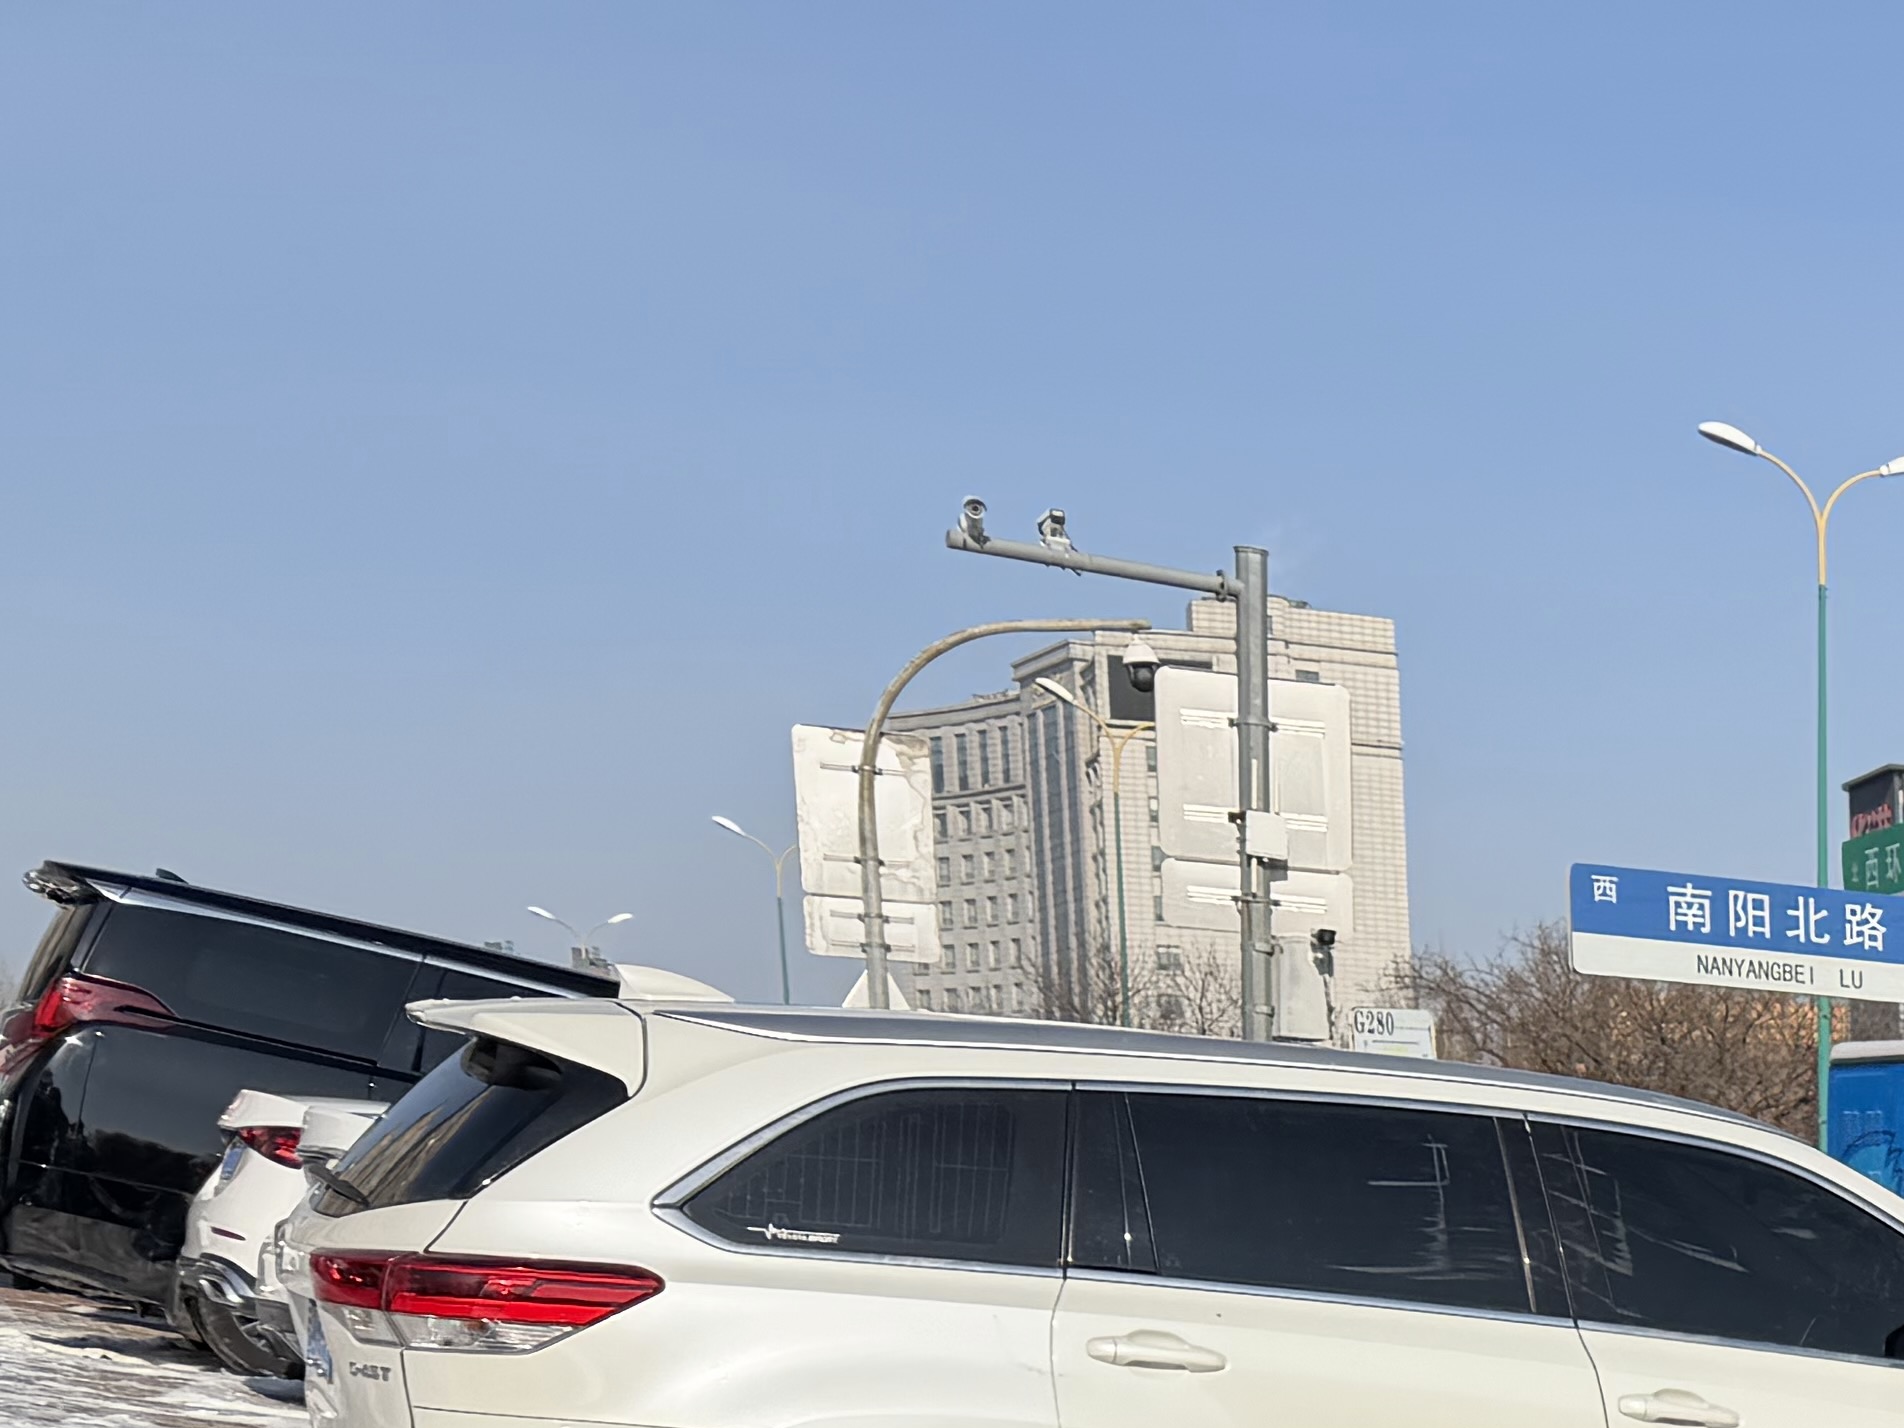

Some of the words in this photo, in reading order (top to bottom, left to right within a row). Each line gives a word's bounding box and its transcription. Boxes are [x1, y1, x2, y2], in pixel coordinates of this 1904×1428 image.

[1591, 874, 1619, 904] 西
[1667, 882, 1887, 952] 南阳北路
[1697, 954, 1814, 985] NANYANGBEI
[1839, 968, 1863, 989] LU
[1354, 1010, 1395, 1036] G280
